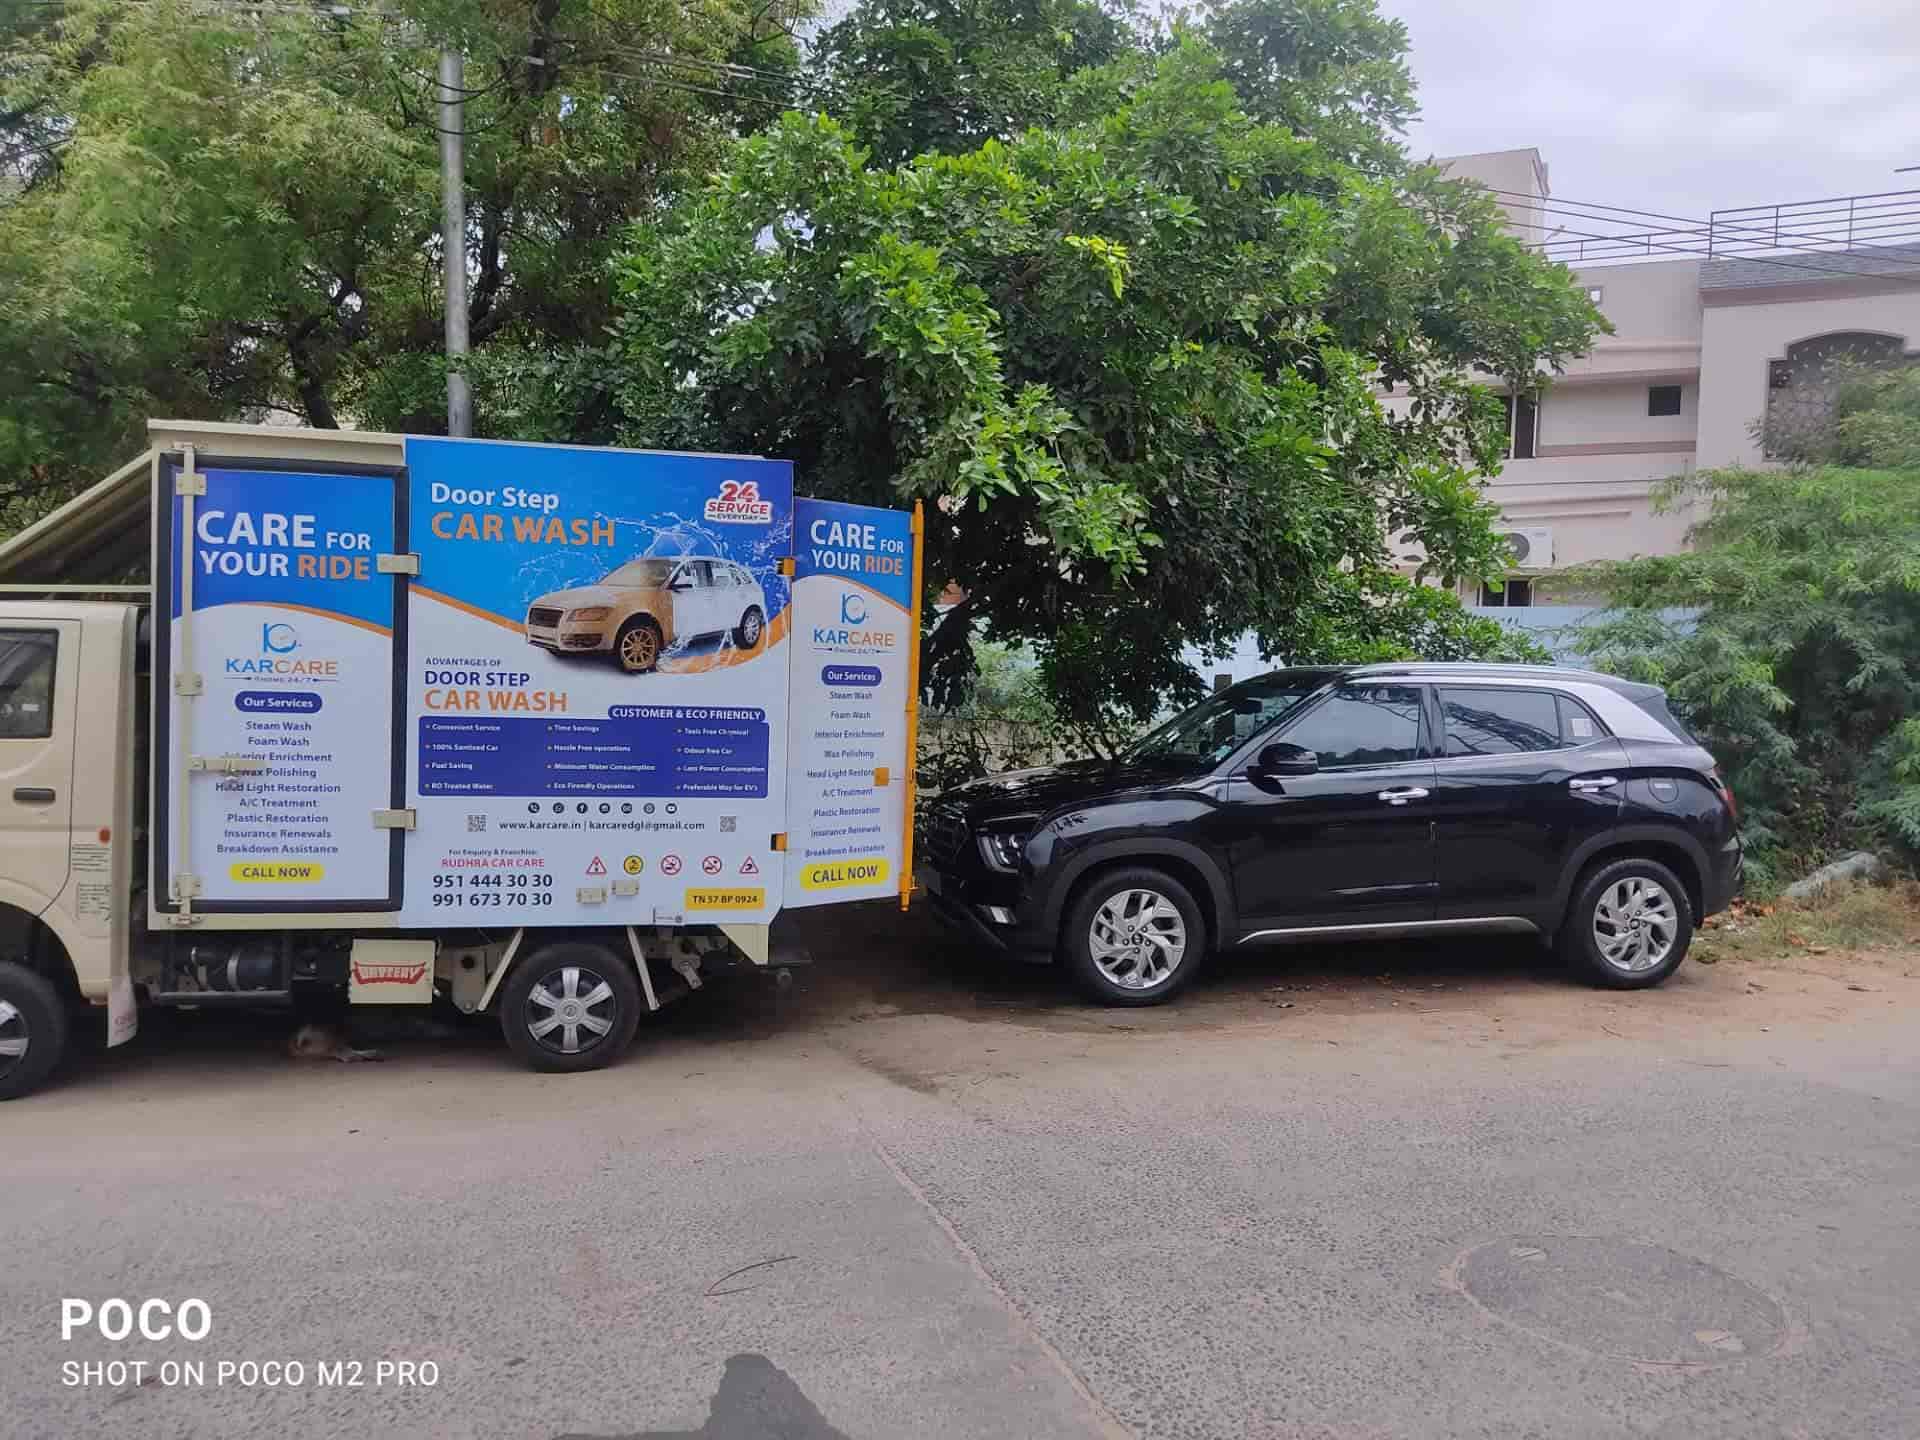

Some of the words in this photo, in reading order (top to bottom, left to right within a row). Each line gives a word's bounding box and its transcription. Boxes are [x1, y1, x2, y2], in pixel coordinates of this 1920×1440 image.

[721, 482, 756, 502] 24
[431, 482, 495, 506] Door
[502, 485, 560, 515] Step
[708, 502, 769, 514] SERVICE
[197, 511, 316, 548] CARE
[326, 532, 371, 550] FOR
[431, 511, 505, 542] CAR
[514, 516, 616, 547] WASH
[811, 519, 875, 550] CARE
[880, 538, 904, 553] FOR
[200, 551, 289, 577] YOUR
[298, 555, 370, 581] RIDE
[812, 549, 860, 572] YOUR
[865, 556, 904, 576] RIDE
[813, 628, 894, 647] KARCARE
[225, 659, 338, 675] KARCARE
[425, 657, 487, 667] ADVANTAGES
[424, 671, 480, 685] DOOR
[485, 672, 530, 687] STEP
[828, 671, 843, 681] Our
[844, 671, 876, 682] Services
[424, 688, 480, 710] CAR
[487, 690, 568, 712] WASH
[829, 691, 853, 700] Steam
[854, 691, 873, 700] Wash
[244, 697, 265, 707] Our
[267, 697, 314, 708] Services
[612, 707, 673, 719] CUSTOMER
[675, 709, 683, 719] &
[685, 709, 707, 720] ECO
[710, 710, 761, 721] FRIENDLY
[831, 710, 851, 720] Foam
[852, 711, 871, 720] Wash
[246, 720, 280, 731] Steam
[282, 720, 312, 732] Wash
[431, 723, 473, 731] Convenient
[474, 724, 501, 732] Service
[554, 724, 571, 732] Time
[814, 729, 842, 739] Interior
[843, 729, 884, 739] Enrichment
[248, 736, 279, 746] Foam
[280, 736, 310, 747] Wash
[432, 743, 453, 751] 100%
[269, 752, 333, 762] Enrichment
[824, 750, 840, 759] Wax
[841, 750, 874, 761] Polishing
[448, 762, 473, 771] Saving
[266, 767, 317, 779] Polishing
[807, 770, 826, 779] Head
[827, 769, 847, 779] Light
[247, 783, 277, 794] Light
[278, 784, 341, 793] Restoration
[431, 782, 443, 790] RO
[444, 782, 471, 790] Treated
[836, 788, 873, 797] Treatment
[239, 798, 260, 808] A/C
[261, 798, 317, 808] Treatment
[813, 808, 838, 818] Plastic
[839, 806, 881, 816] Restoration
[227, 813, 264, 823] Plastic
[265, 813, 329, 824] Restoration
[499, 820, 581, 830] www.karcare.in
[224, 829, 278, 839] Insurance
[280, 829, 332, 839] Renewals
[811, 828, 846, 838] Insurance
[848, 825, 881, 835] Renewals
[216, 844, 279, 854] Breakdown
[281, 844, 339, 854] Assistance
[463, 849, 492, 857] Enquiry
[805, 847, 847, 858] Breakdown
[848, 844, 885, 854] Assistance
[441, 859, 489, 868] RUDHRA
[491, 859, 514, 868] CAR
[516, 859, 545, 868] CARE
[242, 867, 276, 878] CALL
[278, 867, 311, 878] NOW
[812, 870, 844, 884] CALL
[847, 865, 878, 880] NOW
[432, 875, 463, 888] 951
[469, 874, 502, 887] 444
[507, 874, 527, 887] 30
[531, 874, 553, 887] 30
[432, 894, 463, 906] 991
[469, 893, 501, 906] 673
[506, 893, 527, 906] 70
[531, 893, 553, 906] 30
[693, 895, 705, 904] TN
